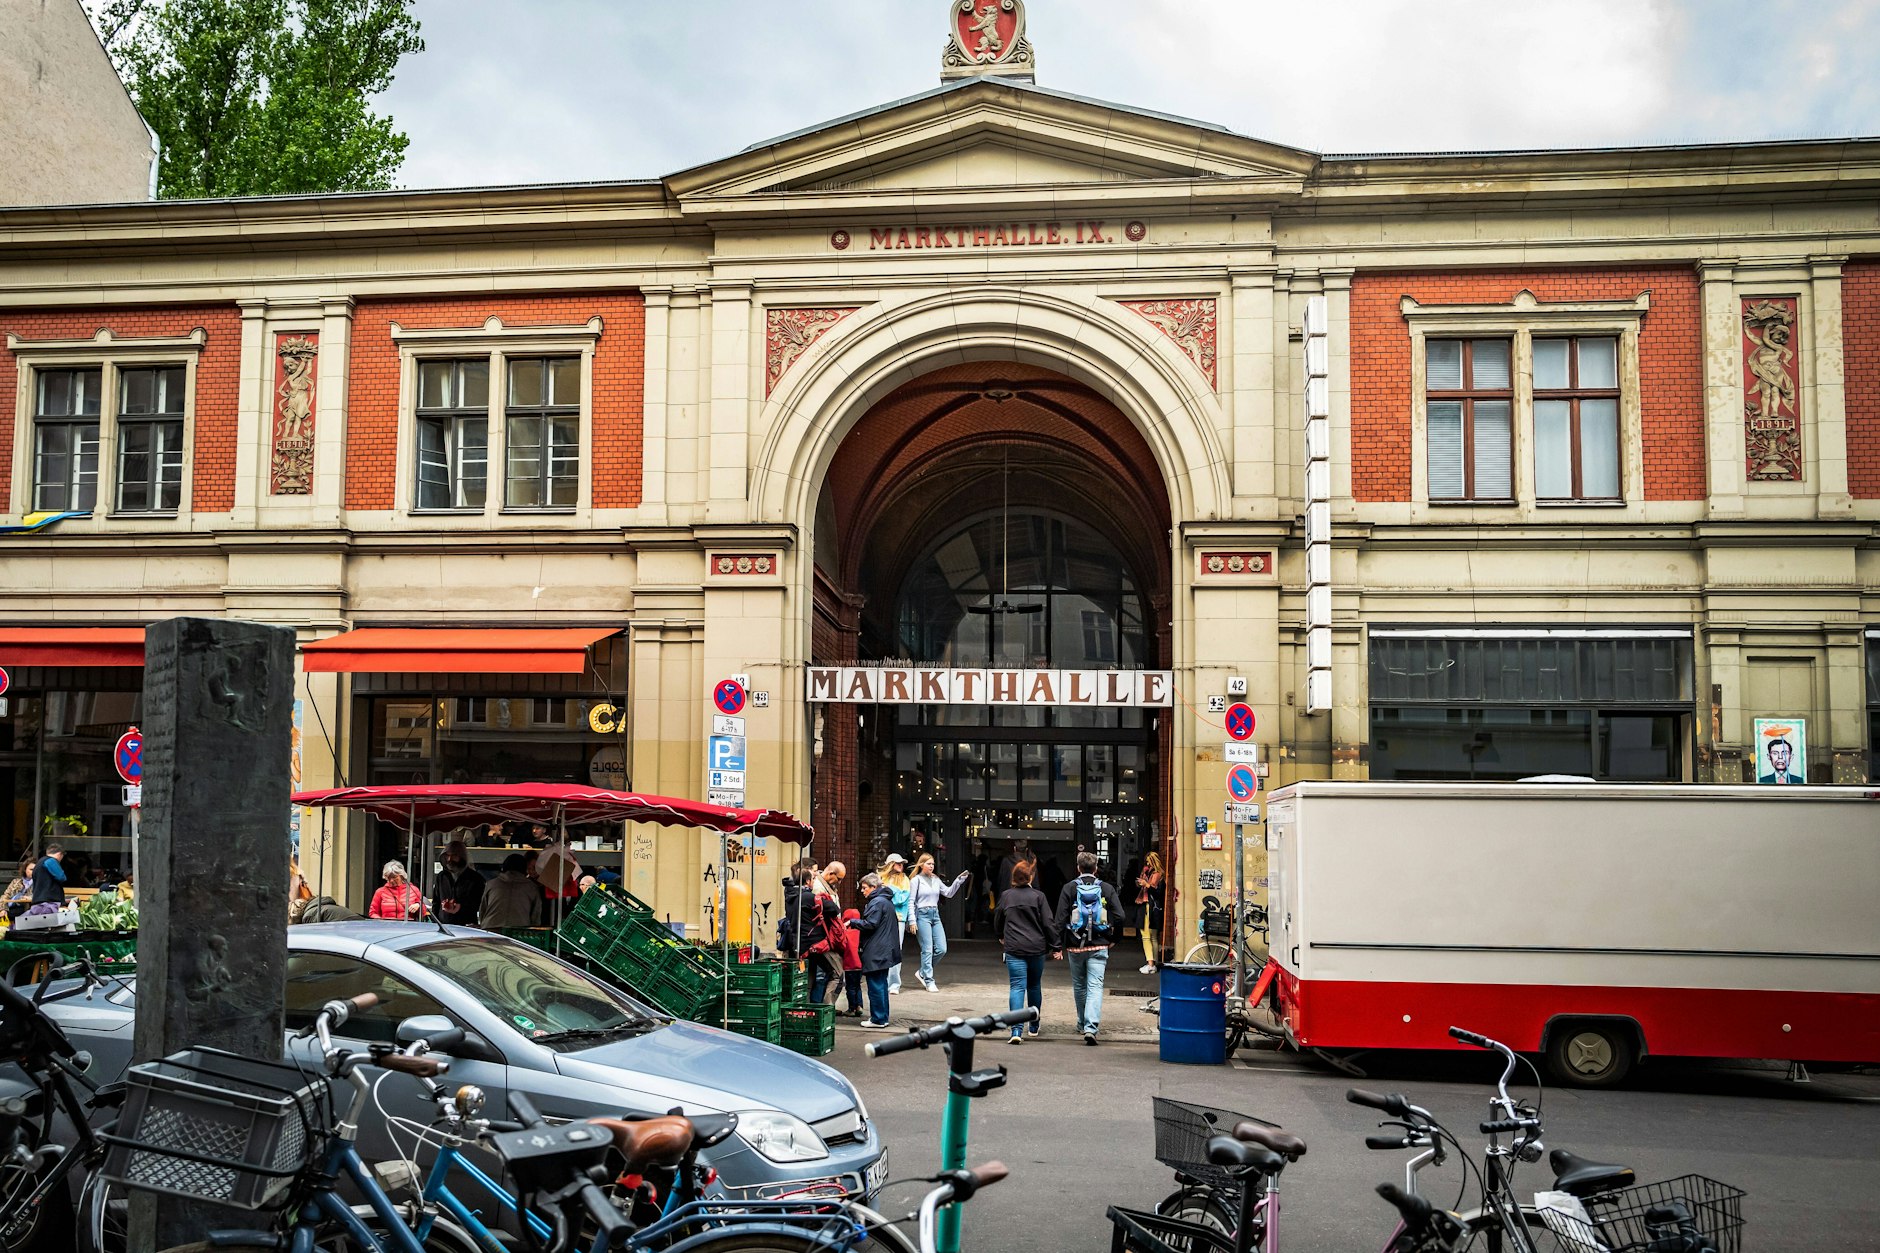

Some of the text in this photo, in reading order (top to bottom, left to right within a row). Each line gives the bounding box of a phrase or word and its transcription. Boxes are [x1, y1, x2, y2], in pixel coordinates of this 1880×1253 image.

[810, 670, 1166, 703] MARKTHALLE
[1232, 680, 1244, 691] 42
[754, 692, 767, 701] 43
[1210, 697, 1224, 707] 42
[725, 718, 734, 726] Sa
[714, 740, 731, 768] P
